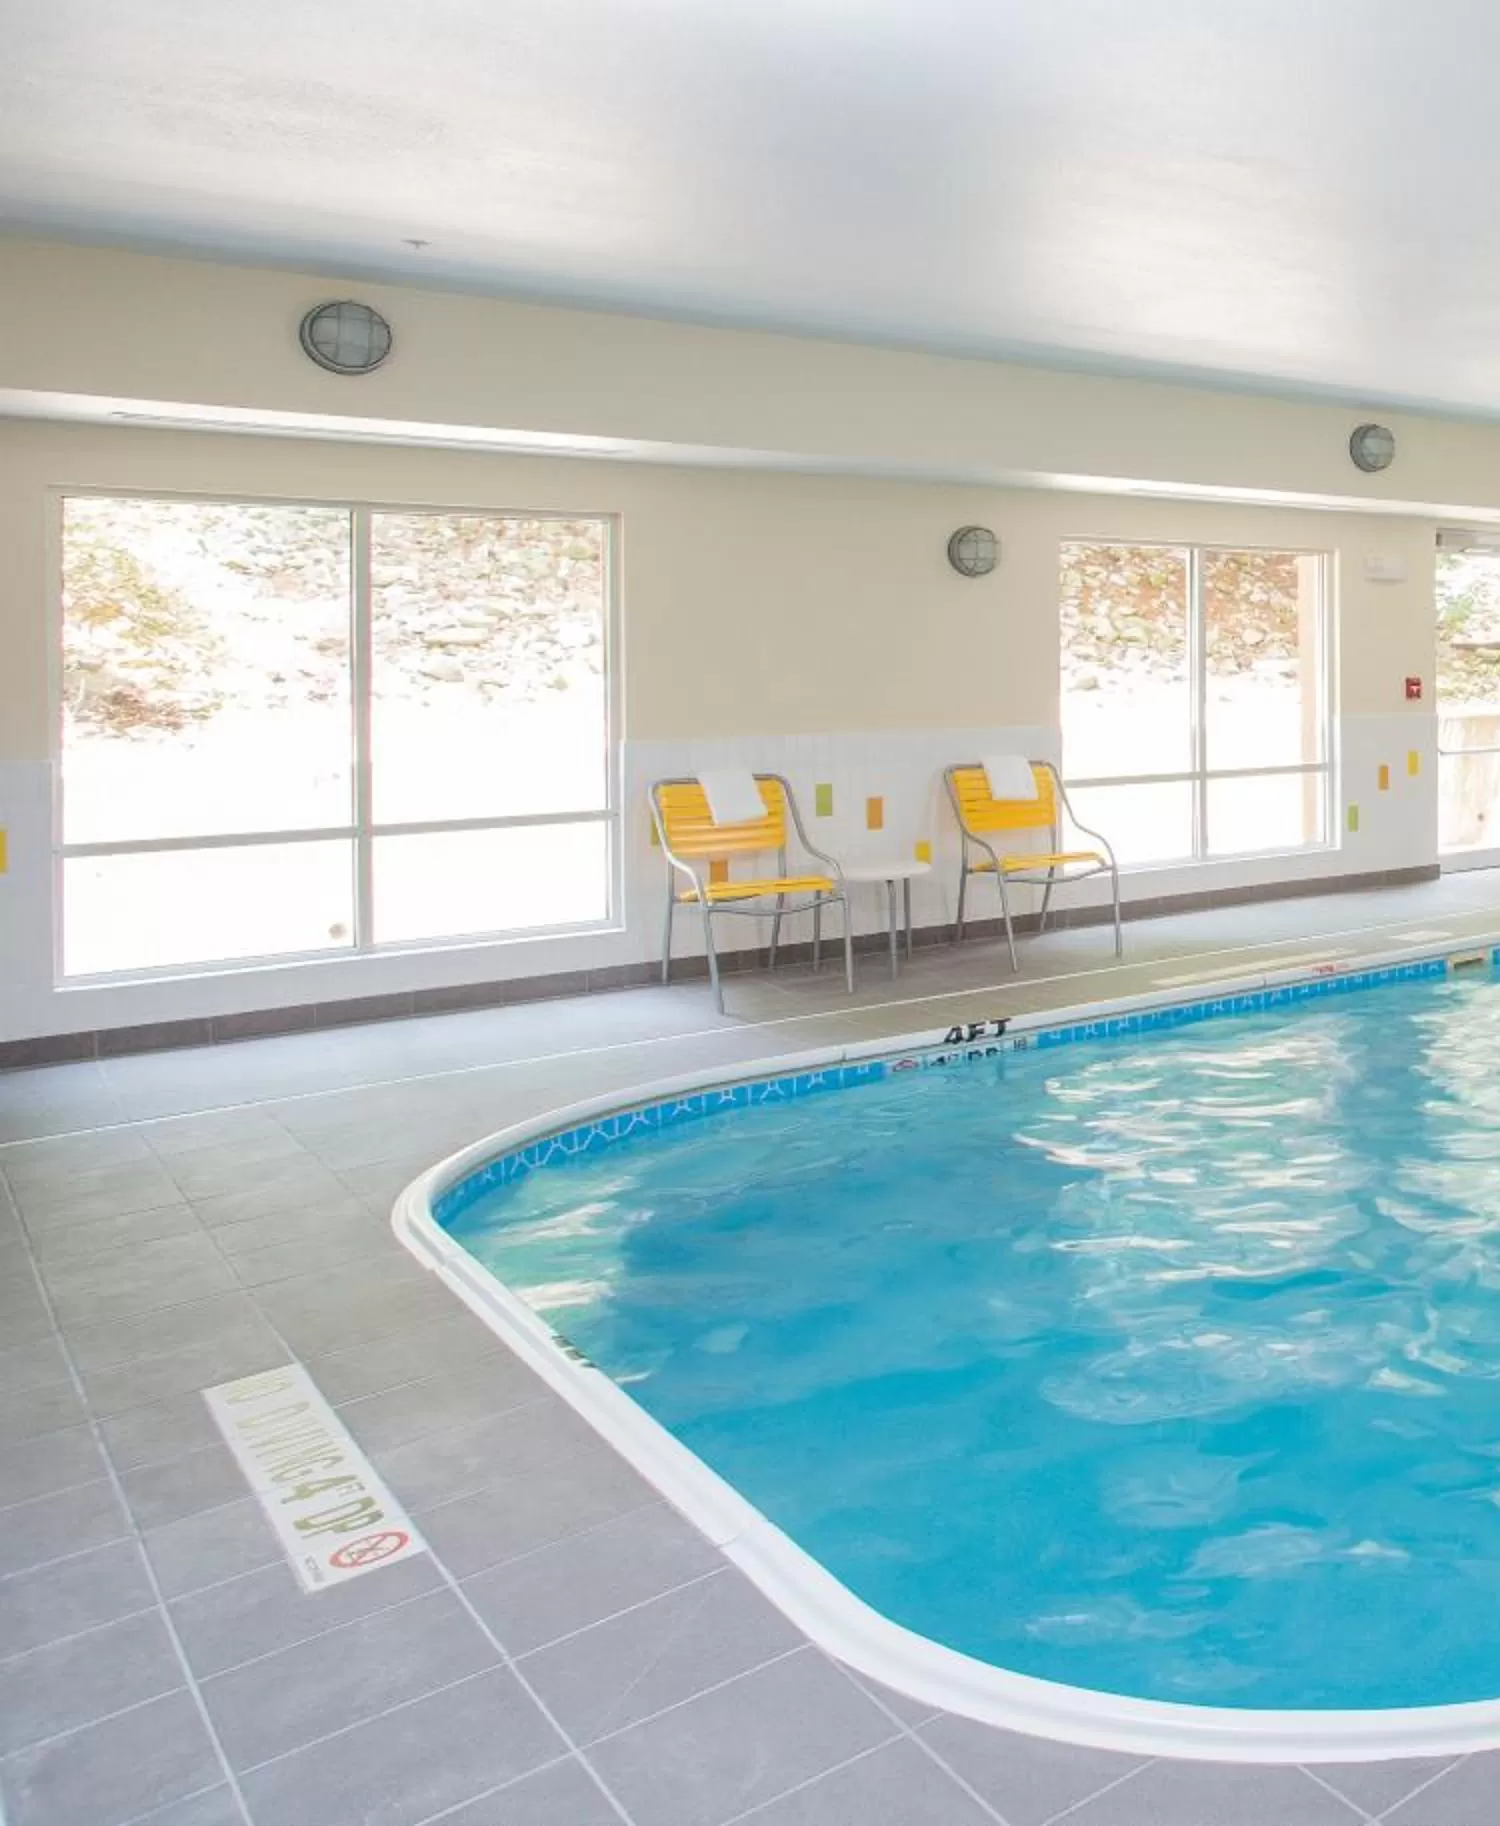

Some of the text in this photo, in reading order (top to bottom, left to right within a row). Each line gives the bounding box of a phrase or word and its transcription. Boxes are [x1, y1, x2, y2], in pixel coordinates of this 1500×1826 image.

[943, 1017, 1012, 1044] 4FT
[225, 1372, 297, 1406] NO
[235, 1400, 346, 1484] DIVING
[292, 1495, 386, 1540] DP
